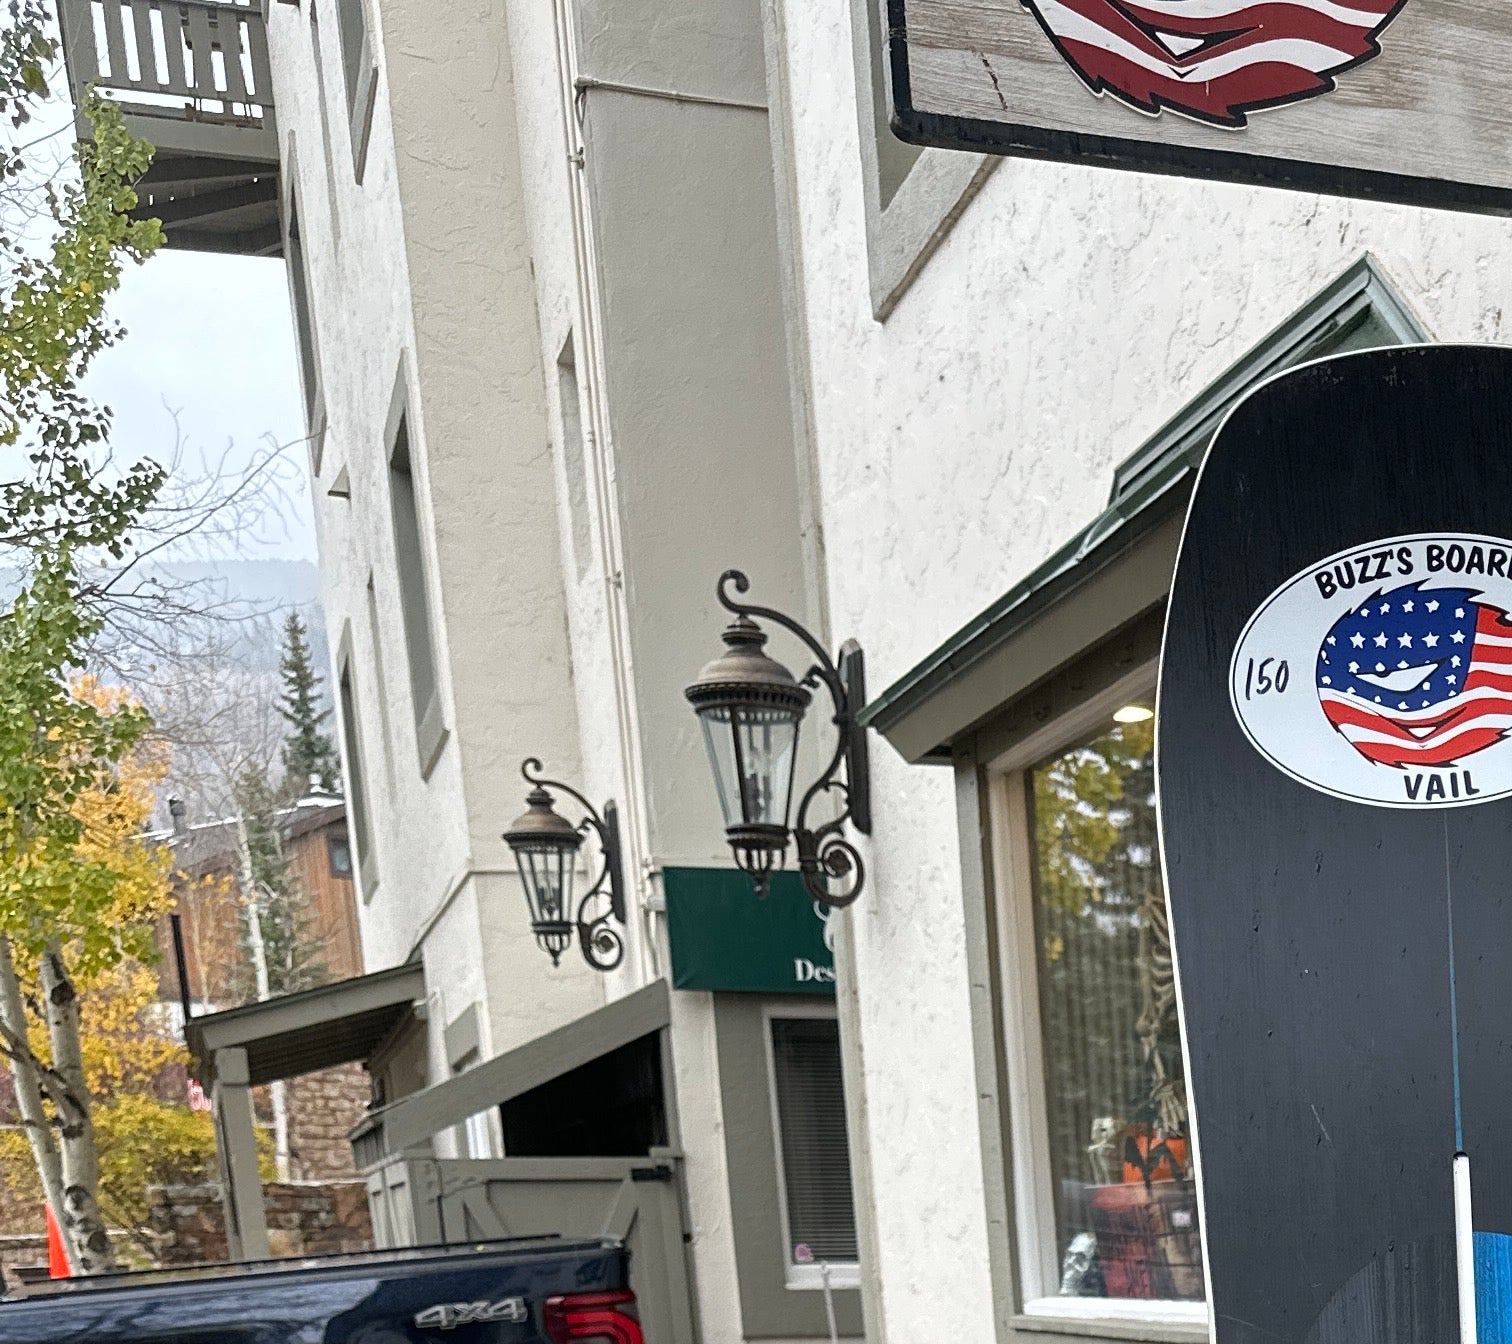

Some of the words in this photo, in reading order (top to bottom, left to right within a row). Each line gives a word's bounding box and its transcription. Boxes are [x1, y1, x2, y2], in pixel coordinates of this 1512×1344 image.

[1314, 546, 1414, 600] BUZZ'S
[1245, 657, 1290, 701] 150
[1403, 769, 1481, 801] VAIL
